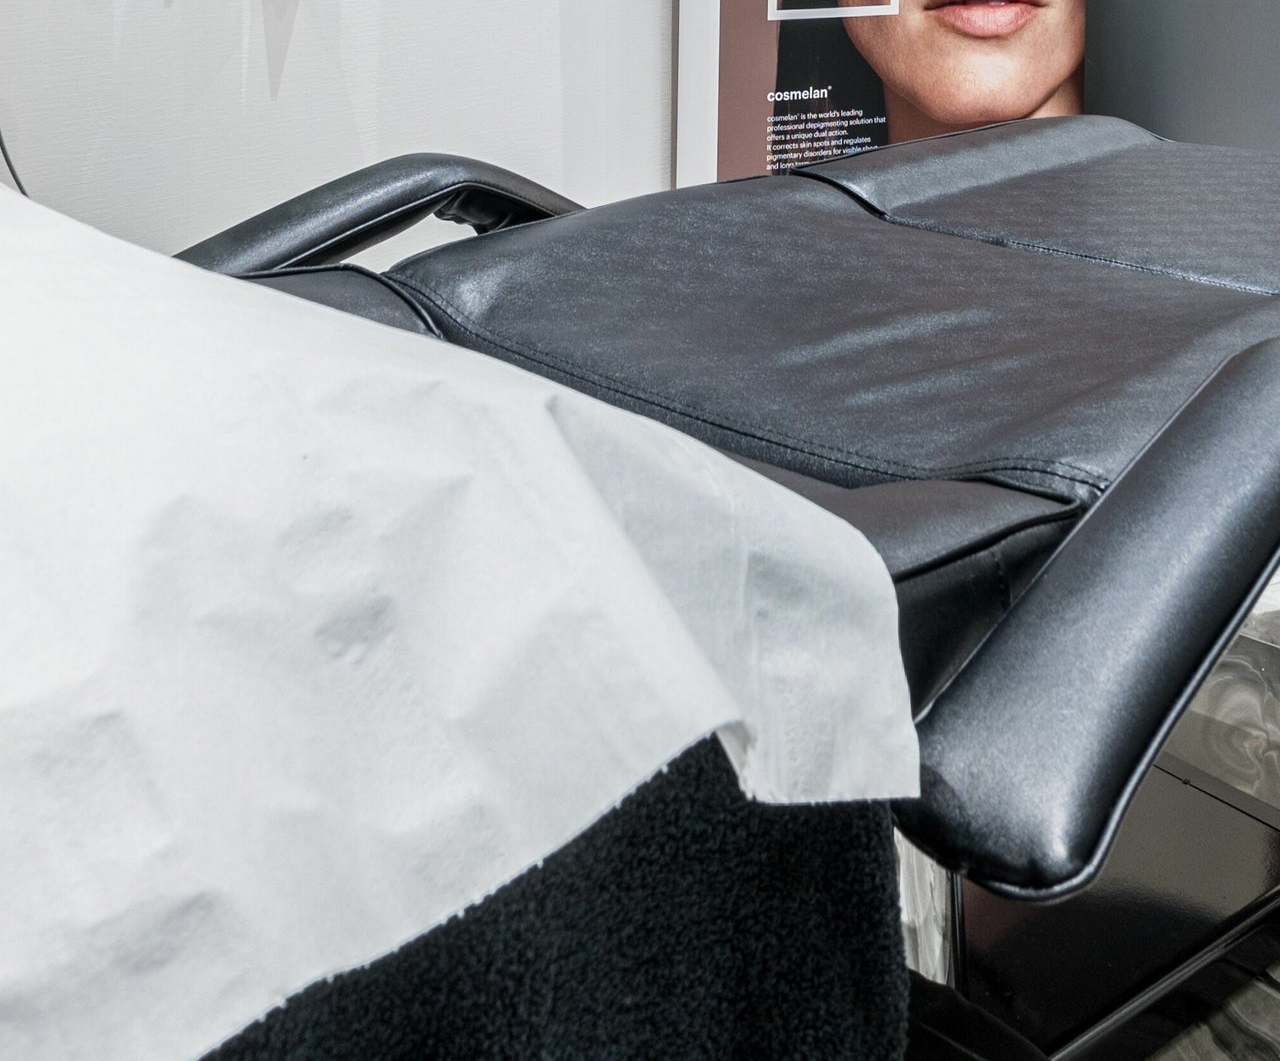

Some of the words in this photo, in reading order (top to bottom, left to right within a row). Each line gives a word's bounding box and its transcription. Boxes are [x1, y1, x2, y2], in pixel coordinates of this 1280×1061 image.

[801, 112, 806, 120] is
[807, 111, 818, 119] the
[841, 109, 863, 117] leading
[767, 122, 805, 133] professional
[806, 119, 848, 129] depigmenting
[849, 118, 873, 126] solution
[874, 116, 886, 124] that
[767, 133, 785, 141] offers
[791, 132, 813, 140] unique
[814, 130, 827, 138] dual
[828, 128, 848, 137] action.
[772, 142, 799, 150] corrects
[800, 141, 812, 149] skin
[813, 140, 830, 148] spots
[831, 138, 843, 146] and
[843, 136, 871, 145] regulates
[767, 152, 802, 162] pigmentary
[803, 149, 832, 158] disorders
[833, 147, 842, 155] for
[767, 162, 779, 170] and
